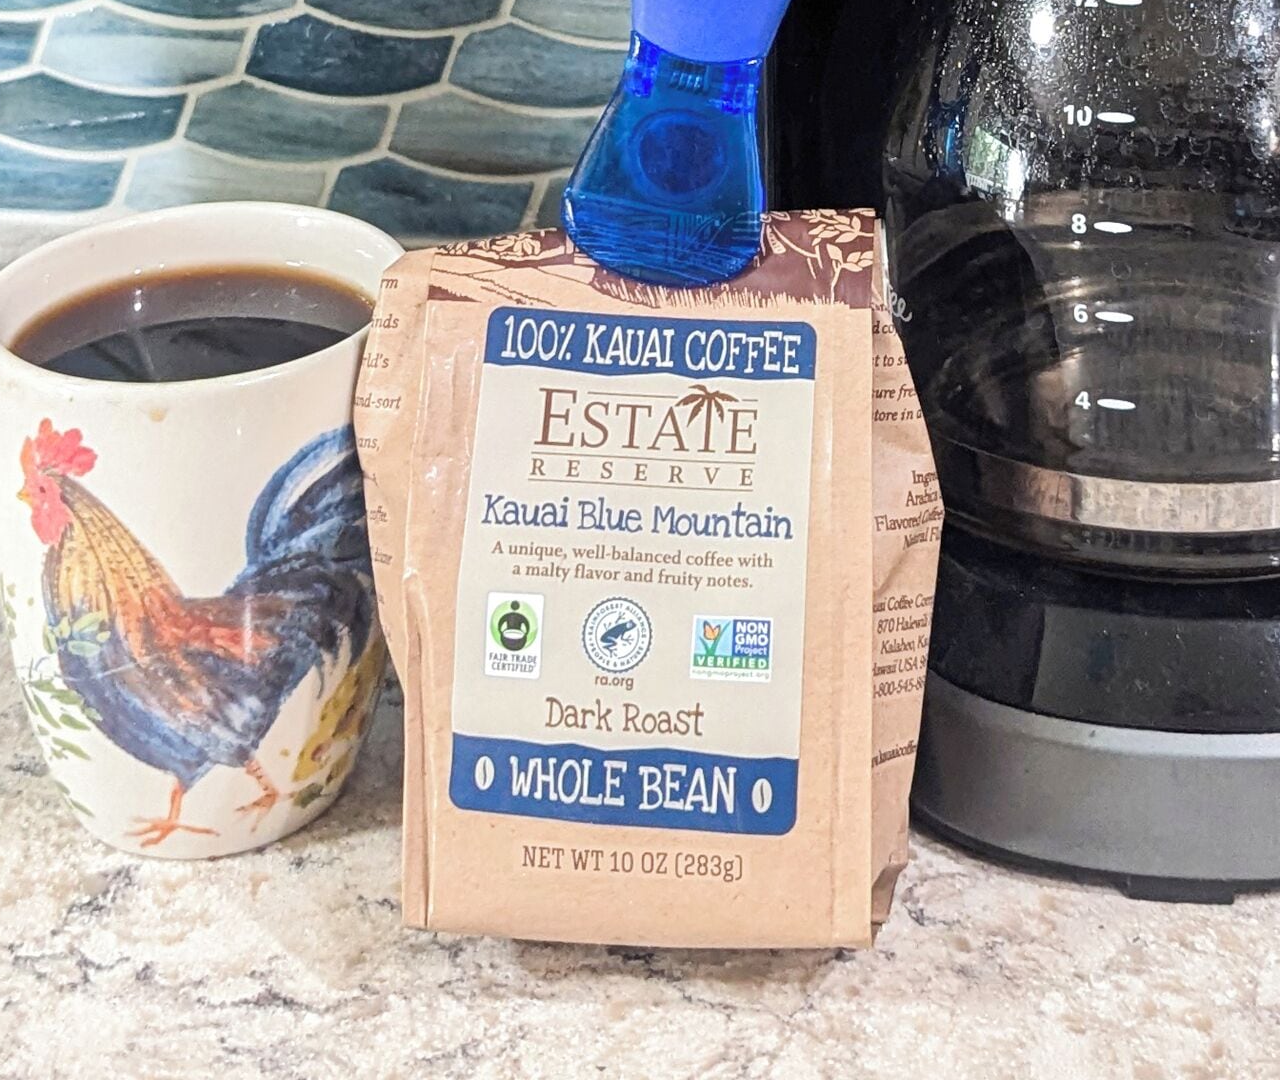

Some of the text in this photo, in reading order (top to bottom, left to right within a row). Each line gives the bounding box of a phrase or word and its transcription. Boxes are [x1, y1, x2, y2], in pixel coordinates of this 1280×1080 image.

[1063, 104, 1093, 127] 10
[1071, 213, 1087, 234] 8
[1073, 303, 1089, 323] 6
[501, 315, 801, 374] 100% KAUAI COFFEE
[883, 353, 895, 367] to
[1075, 391, 1091, 410] 4
[534, 385, 758, 455] ESTATE
[900, 407, 913, 421] in
[530, 458, 753, 487] RESERVE
[481, 494, 794, 539] Kauai Blue Mountain
[491, 541, 774, 569] A unique, well-balanced coffee with
[512, 562, 753, 591] a malty flavor and fruity notes.
[735, 621, 769, 634] NON
[735, 633, 769, 646] GMO
[488, 652, 538, 665] FAIR TRADE
[734, 644, 768, 656] Project
[491, 661, 535, 673] CERTIFIED
[695, 656, 768, 669] VERIFIED
[898, 655, 918, 673] USA
[594, 674, 634, 690] ra.org
[544, 696, 705, 736] Dark Roast
[509, 755, 738, 814] WHOLE BEAN
[521, 845, 743, 882] NET WT 10 OZ (283g)
